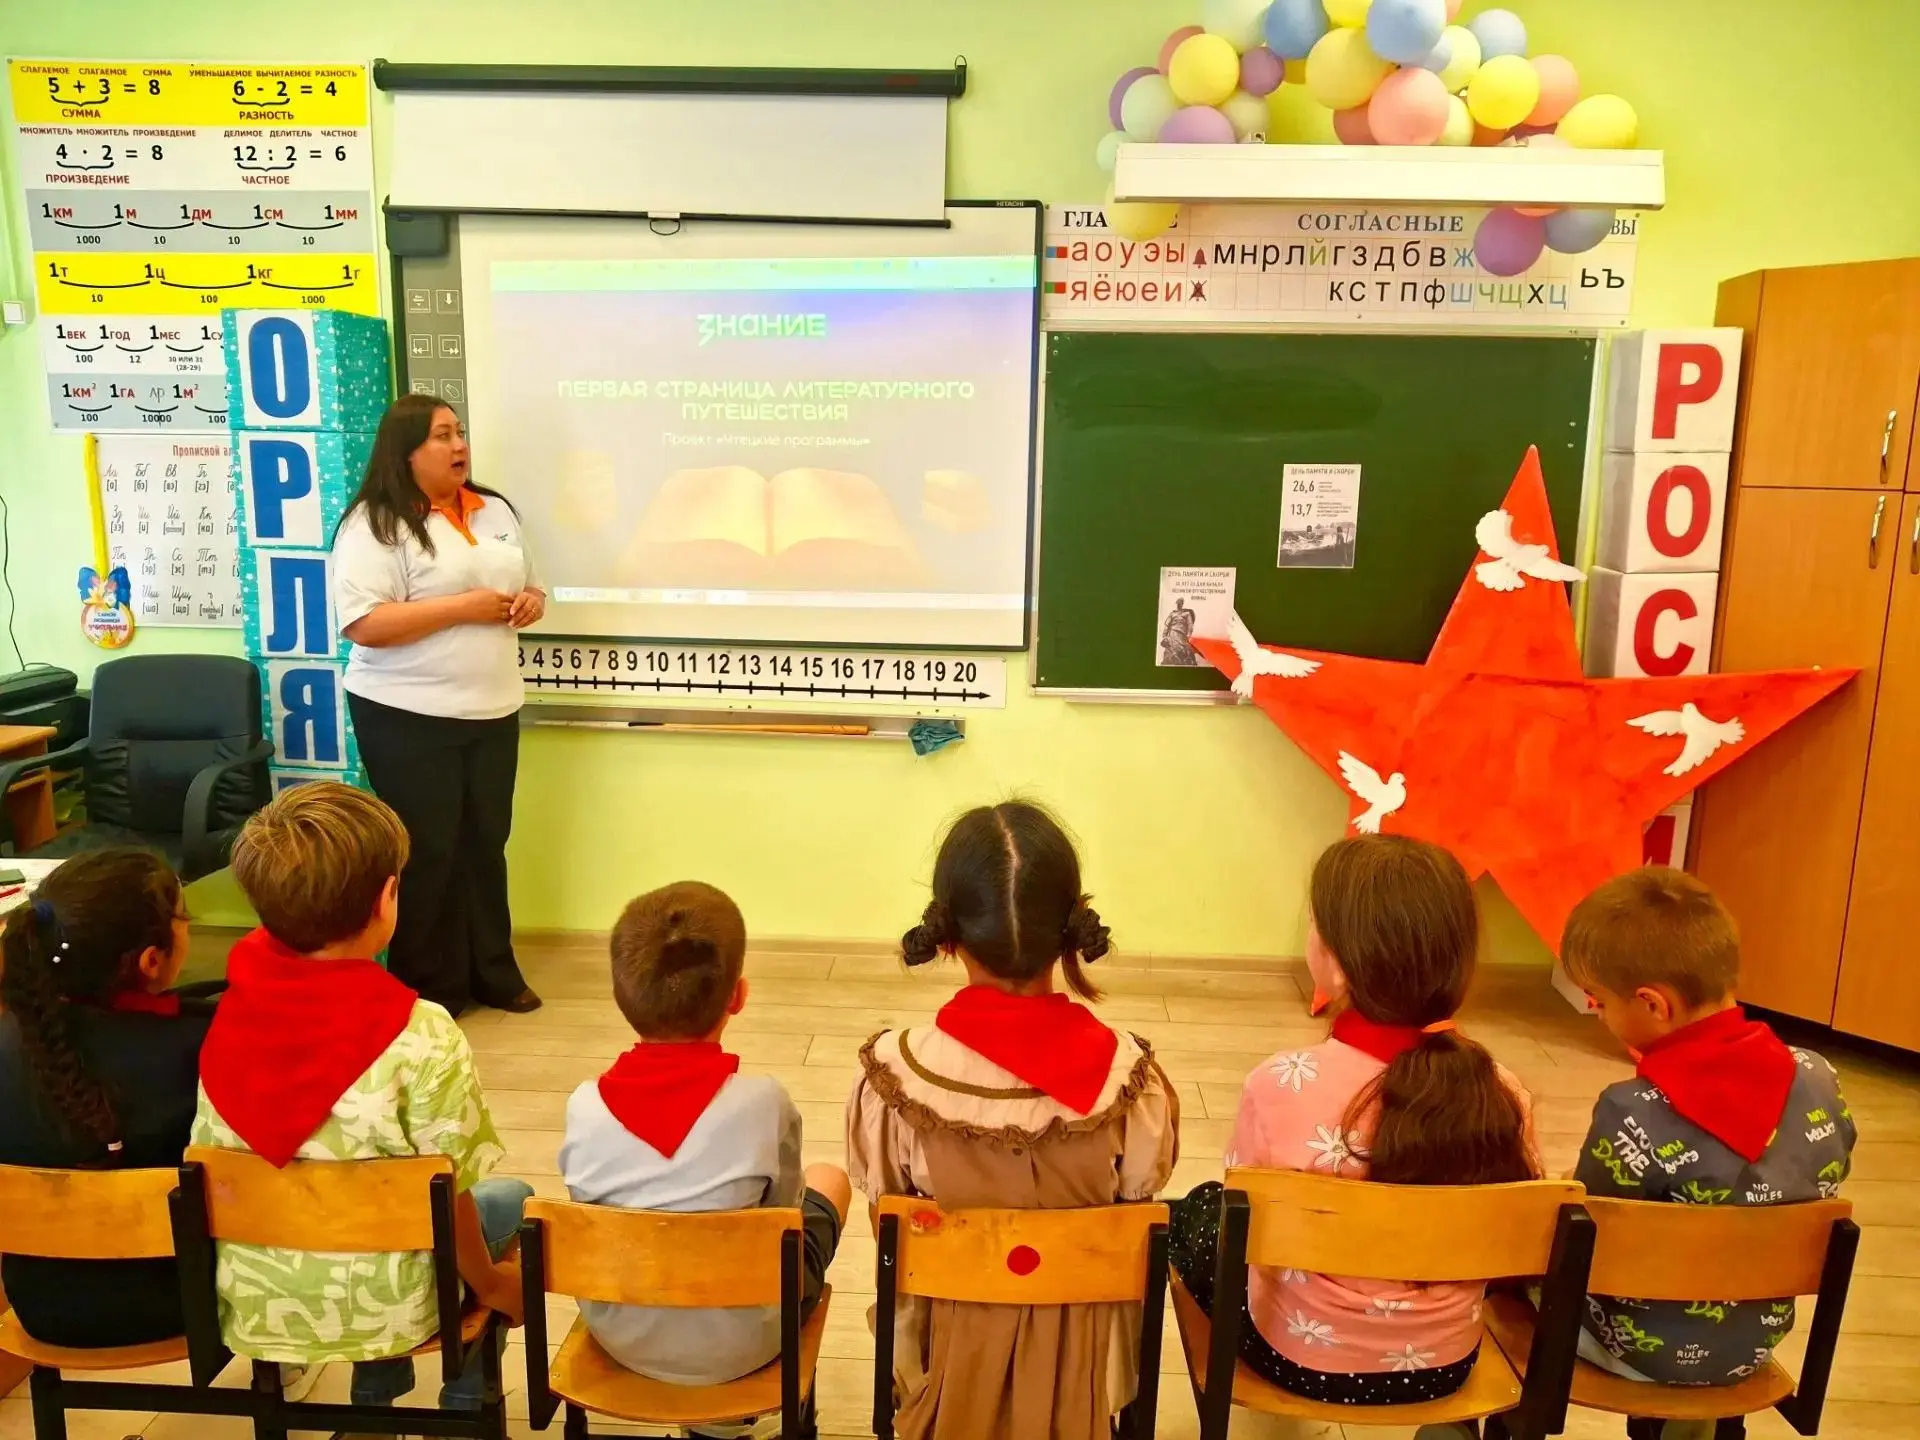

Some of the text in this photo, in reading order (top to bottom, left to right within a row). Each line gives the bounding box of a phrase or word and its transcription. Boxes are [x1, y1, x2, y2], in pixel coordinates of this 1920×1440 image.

[21, 66, 70, 75] СЛАГАЕМОЕ
[78, 68, 127, 76] СЛАГАЕМОЕ
[189, 69, 253, 77] УМЕНЬШАЕМОЕ
[48, 77, 59, 94] 5
[99, 78, 110, 95] 3
[149, 79, 161, 96] 8
[233, 80, 245, 96] 6
[276, 80, 288, 97] 2
[325, 80, 337, 96] 4
[62, 108, 101, 118] СУММА
[239, 111, 294, 120] РАЗНОСТЬ
[19, 126, 196, 138] МНОЖИТЕЛЬ МНОЖИТЕЛЬ ПРОИЗВЕДЕНИЕ
[223, 130, 358, 138] ДЕЛИМОЕ ДЕЛИТЕЛЬ ЧАСТНОЕ
[56, 143, 68, 160] 4
[102, 144, 113, 160] 2
[152, 144, 163, 161] 8
[233, 145, 257, 161] 12
[285, 145, 297, 161] 2
[335, 145, 346, 161] 6
[46, 174, 130, 184] ПРОИЗВЕДЕНИЕ
[241, 176, 290, 184] ЧАСТНОЕ
[1298, 213, 1464, 232] СОГЛАСНЫЕ
[76, 235, 315, 245] 1000 10 10 10
[91, 294, 325, 304] 10 100 1000
[75, 354, 141, 363] 100 12
[557, 380, 975, 400] ПЕРВАЯ СТРАНИЦА ЛИТЕРАТУРНОГО
[682, 402, 848, 421] ПУТЕШЕСТВИЯ
[81, 414, 99, 422] 100
[208, 415, 226, 424] 100
[172, 444, 220, 458] Прописной
[1292, 480, 1315, 494] 26,6
[1290, 503, 1312, 517] 13,7
[532, 647, 544, 668] 4
[552, 648, 563, 669] 5
[570, 649, 582, 669] 6
[589, 649, 600, 670] 7
[608, 650, 619, 670] 8
[626, 650, 638, 671] 9
[646, 651, 668, 672] 10
[677, 652, 697, 673] 11
[707, 653, 730, 674] 12
[738, 654, 761, 676] 13
[769, 655, 792, 676] 14
[800, 656, 823, 678] 15
[831, 657, 854, 679] 16
[861, 658, 884, 680] 17
[892, 659, 915, 681] 18
[923, 660, 946, 682] 19
[953, 662, 976, 683] 20
[1613, 1130, 1651, 1178] THE
[1752, 1183, 1770, 1192] NO
[1745, 1190, 1783, 1203] RULES
[1676, 1350, 1711, 1359] RULES
